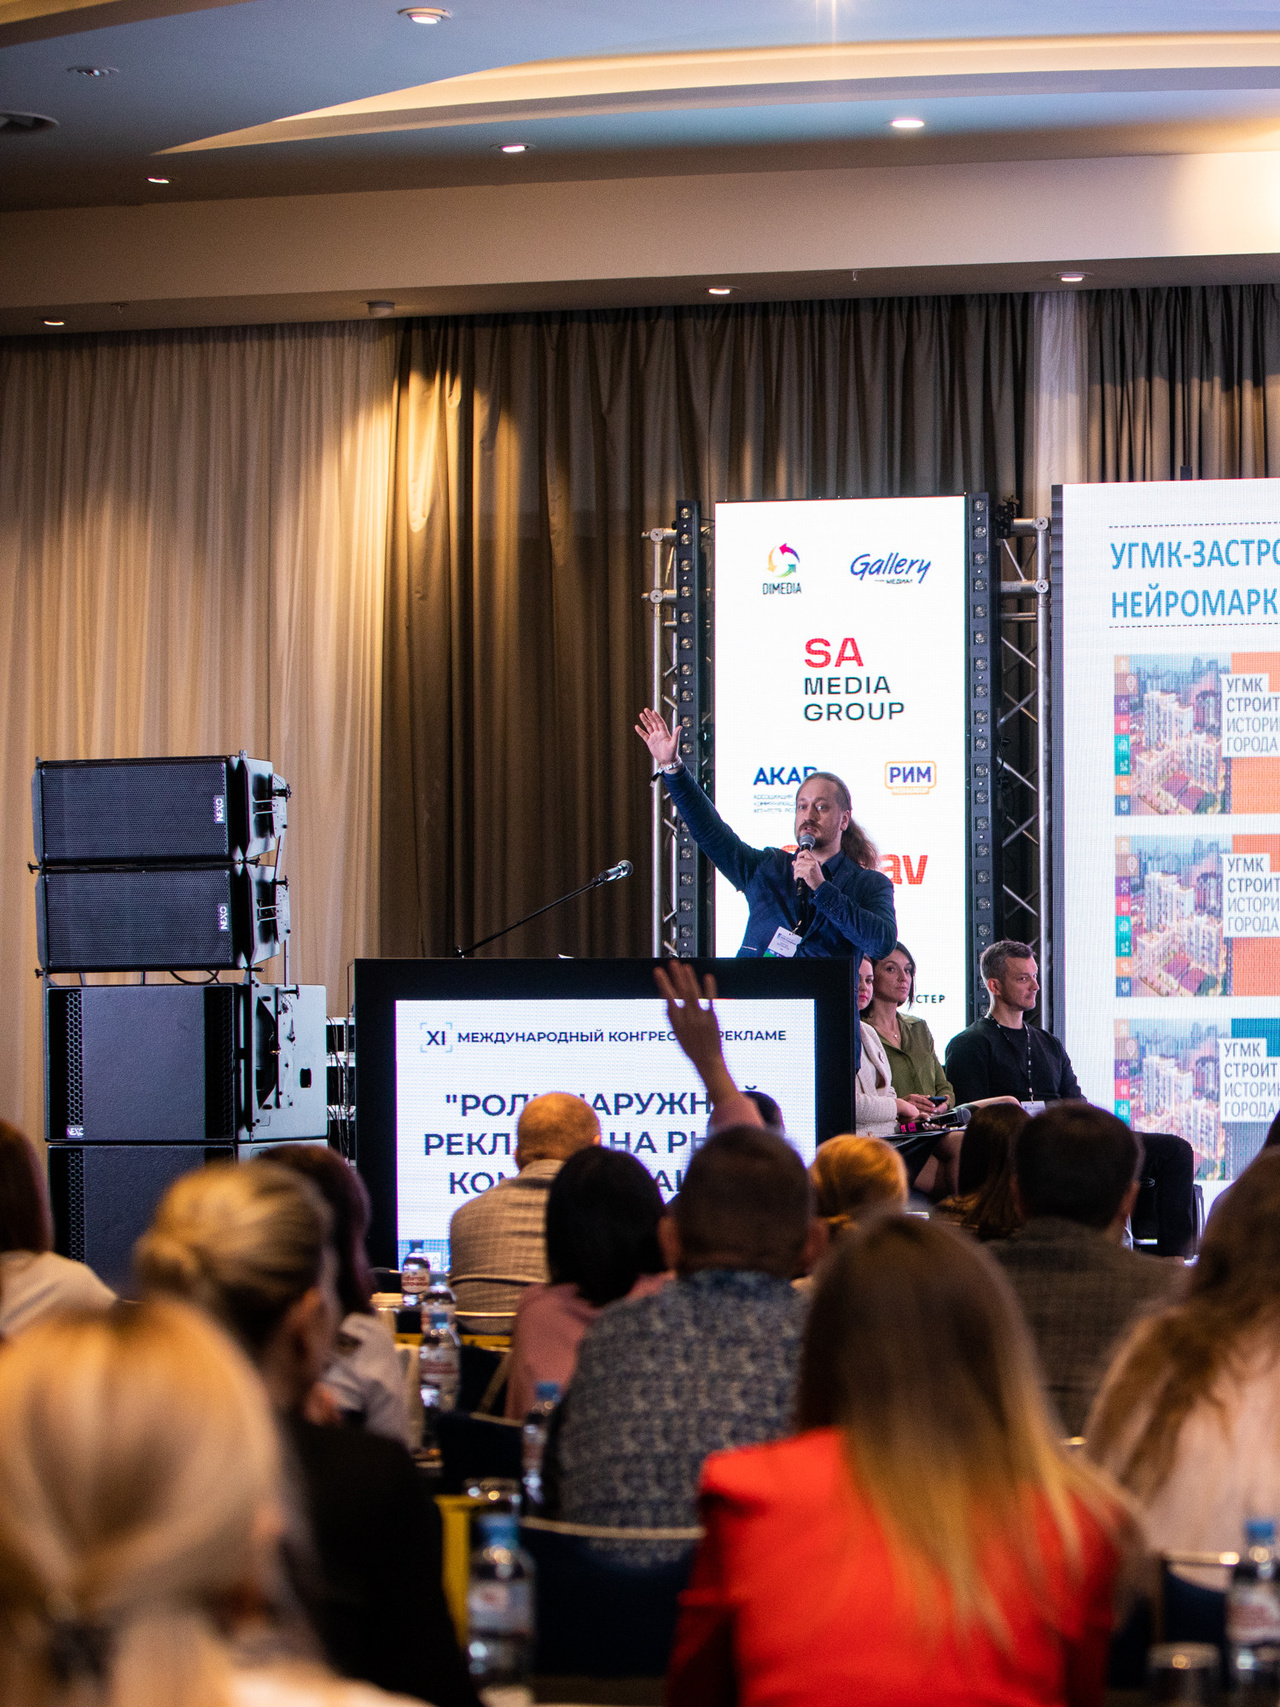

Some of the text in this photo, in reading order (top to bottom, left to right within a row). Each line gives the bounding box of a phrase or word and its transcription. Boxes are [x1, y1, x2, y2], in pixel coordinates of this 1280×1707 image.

[850, 552, 931, 584] Gallery
[762, 582, 802, 595] DIMEDIA
[804, 637, 864, 668] SA
[804, 676, 891, 695] MEDIA
[1226, 677, 1263, 693] УГМК
[804, 702, 904, 721] GROUP
[1226, 697, 1280, 712] СТРОИТ
[1226, 737, 1278, 753] ГОРОДА
[889, 766, 932, 783] РИМ
[215, 798, 224, 822] NEXO
[1227, 857, 1264, 872] УГМК
[219, 906, 228, 930] NEXO
[1227, 917, 1279, 933] ГОРОДА
[426, 1030, 446, 1046] XI
[457, 1029, 604, 1044] МЕЖДУНАРОДНЫЙ
[608, 1030, 677, 1042] КОНГРЕС
[1224, 1042, 1261, 1057] УГМК
[1224, 1062, 1278, 1078] СТРОИТ
[445, 1093, 538, 1117] "РОЛ
[1224, 1102, 1275, 1118] ГОРОДА
[424, 1132, 511, 1156] РЕКЛ
[609, 1131, 657, 1154] НА
